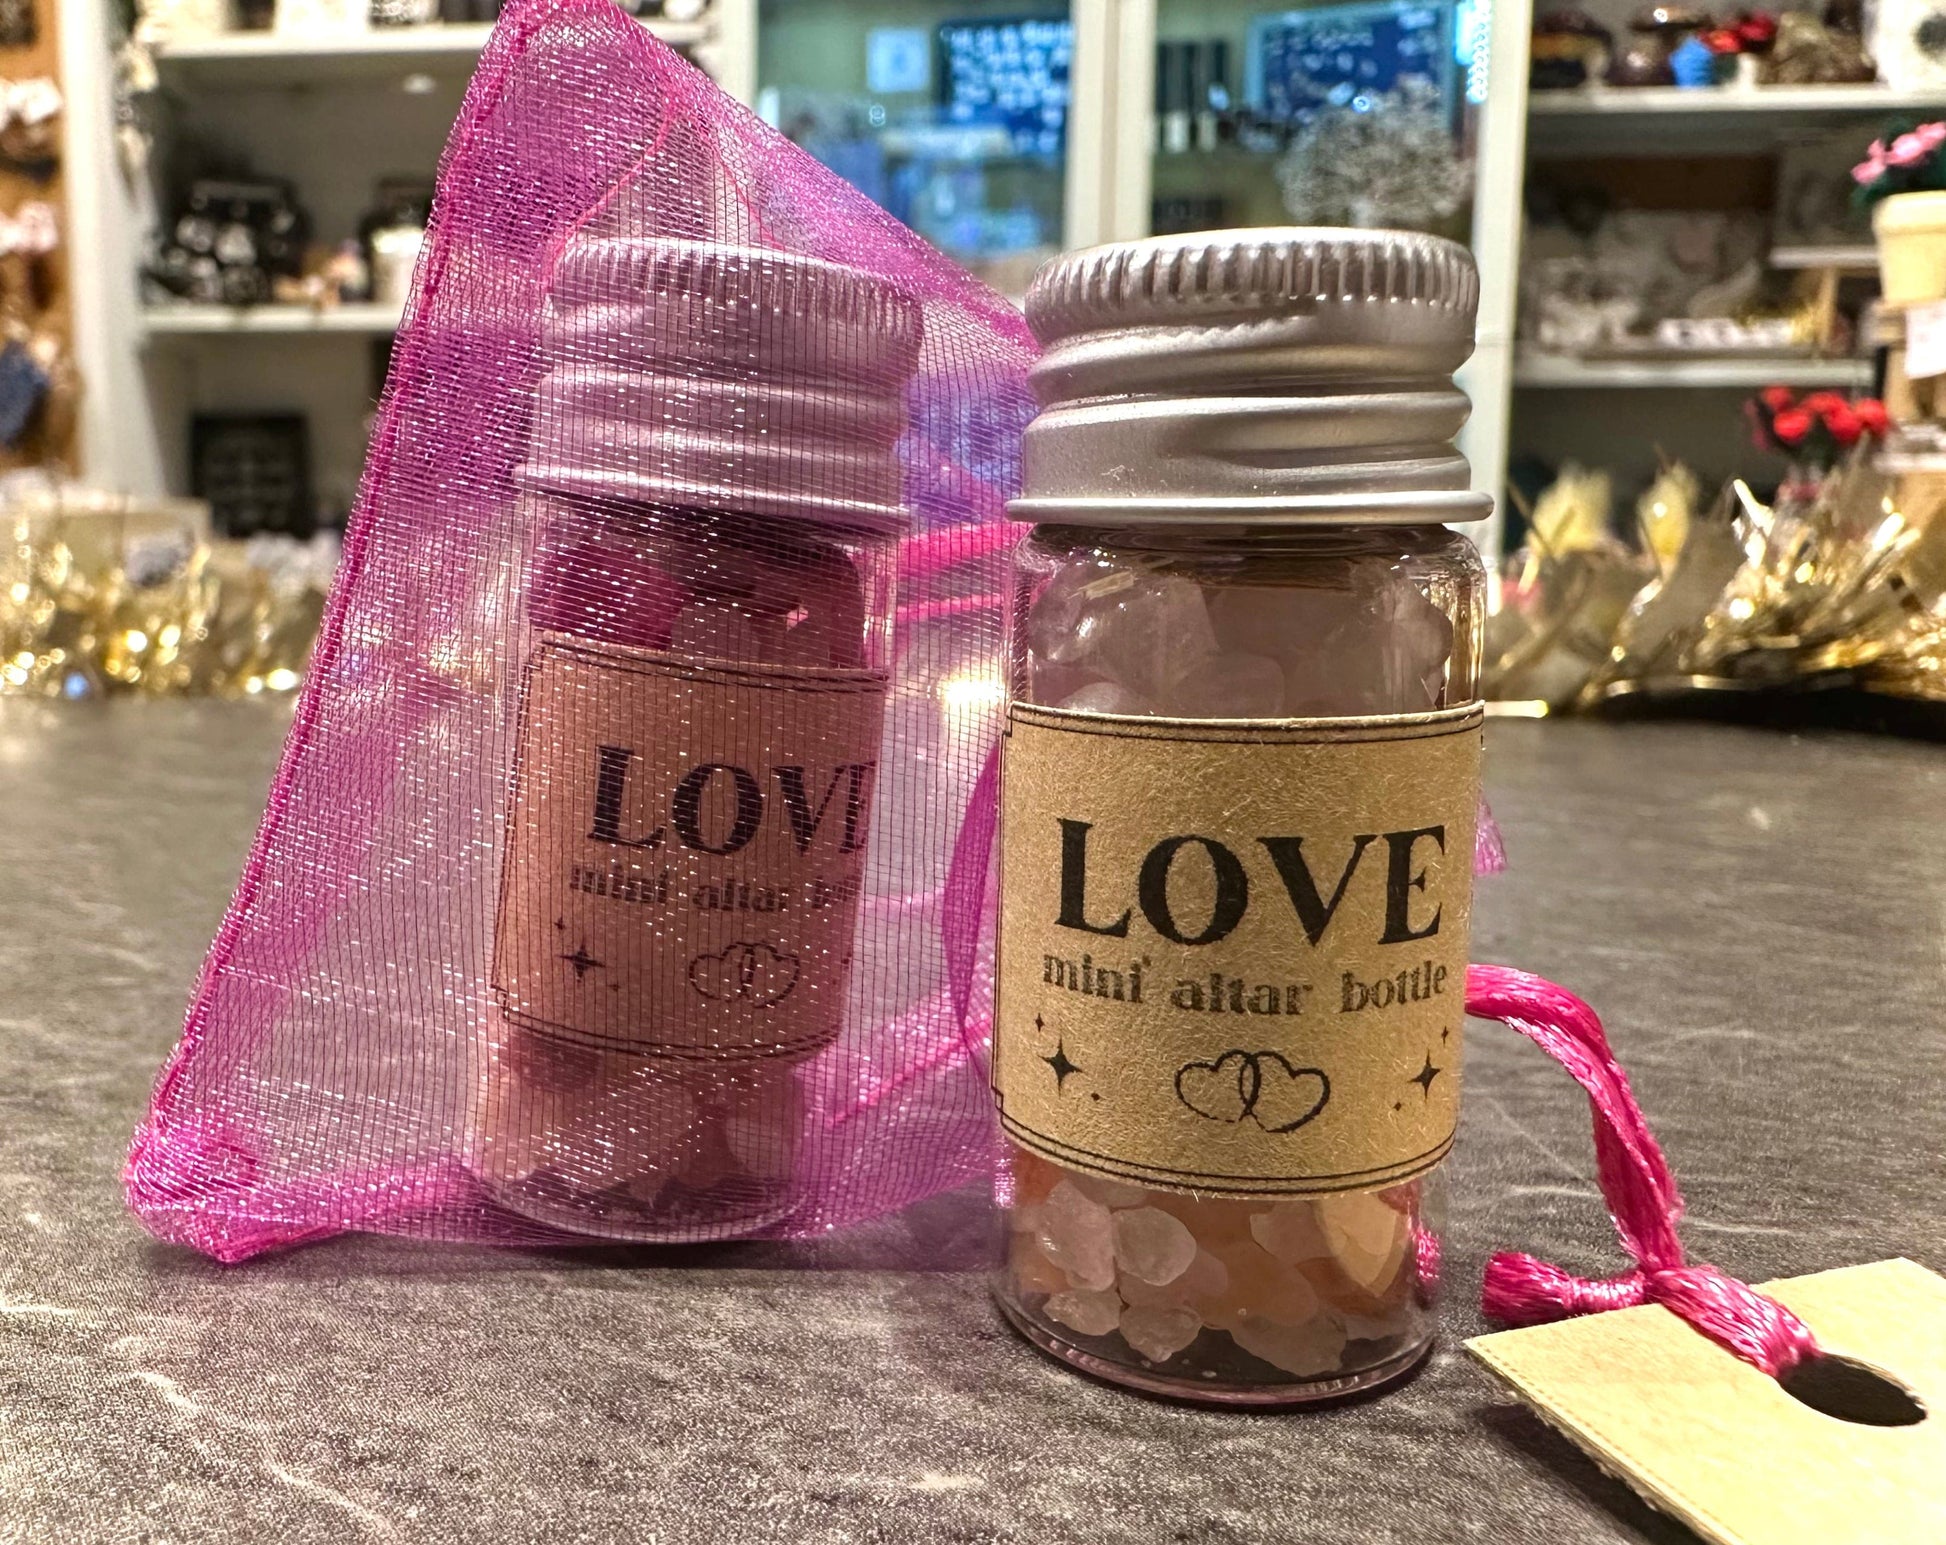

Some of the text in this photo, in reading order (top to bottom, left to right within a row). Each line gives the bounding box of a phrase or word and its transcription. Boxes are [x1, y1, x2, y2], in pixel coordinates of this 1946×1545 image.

[692, 876, 790, 912] altar
[1054, 817, 1446, 947] LOVE
[1043, 953, 1448, 1015] mini altar bottle
